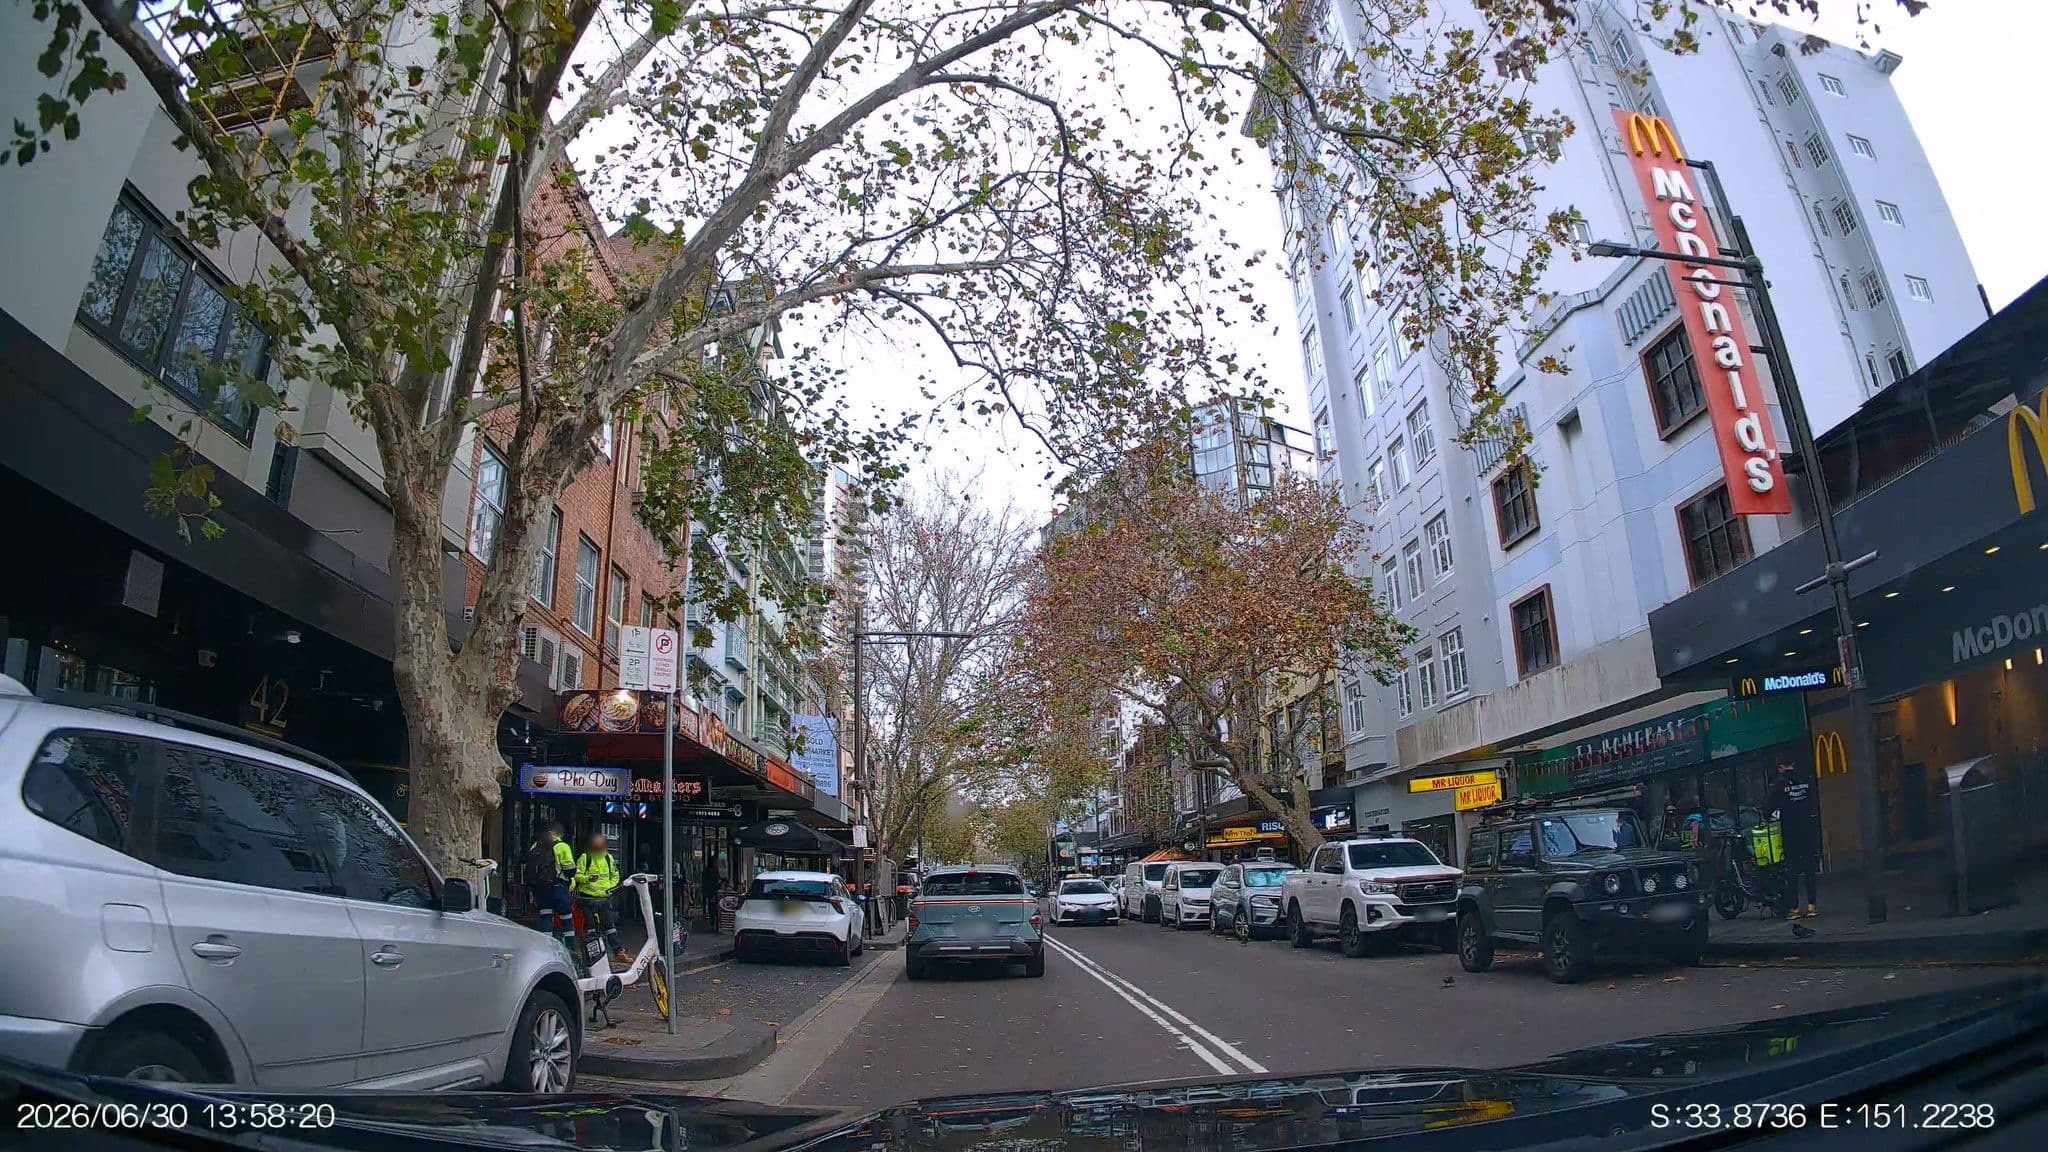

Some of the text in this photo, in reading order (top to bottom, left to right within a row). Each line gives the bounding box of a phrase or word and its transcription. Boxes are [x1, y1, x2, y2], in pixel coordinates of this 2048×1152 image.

[1650, 166, 1776, 494] McDonald's
[1952, 603, 2048, 664] McDon
[628, 658, 640, 666] 2P
[1764, 671, 1826, 691] McDonald's
[250, 673, 289, 728] 42
[557, 769, 618, 793] Pho Duy
[1432, 775, 1476, 789] MR LIQUOR
[1459, 785, 1497, 806] MR LIQUOR
